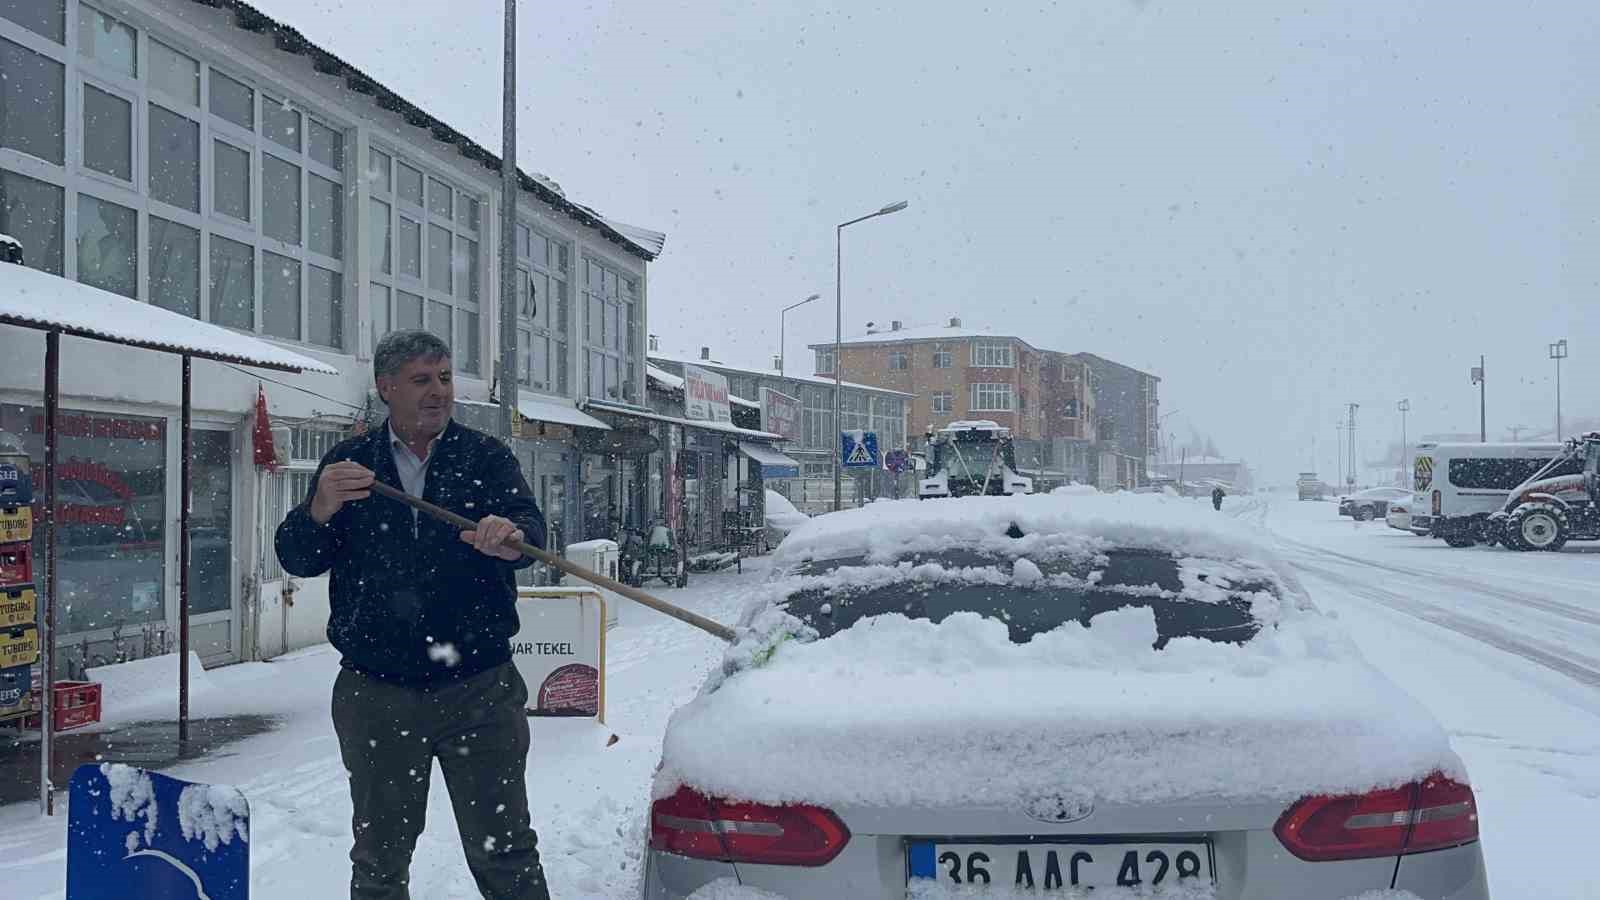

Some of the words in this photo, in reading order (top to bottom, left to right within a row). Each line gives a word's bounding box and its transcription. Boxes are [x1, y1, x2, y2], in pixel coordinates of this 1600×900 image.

[2, 640, 33, 656] TUBORG
[536, 642, 575, 655] TEKEL
[938, 851, 991, 885] 36
[1015, 850, 1094, 889] AAC
